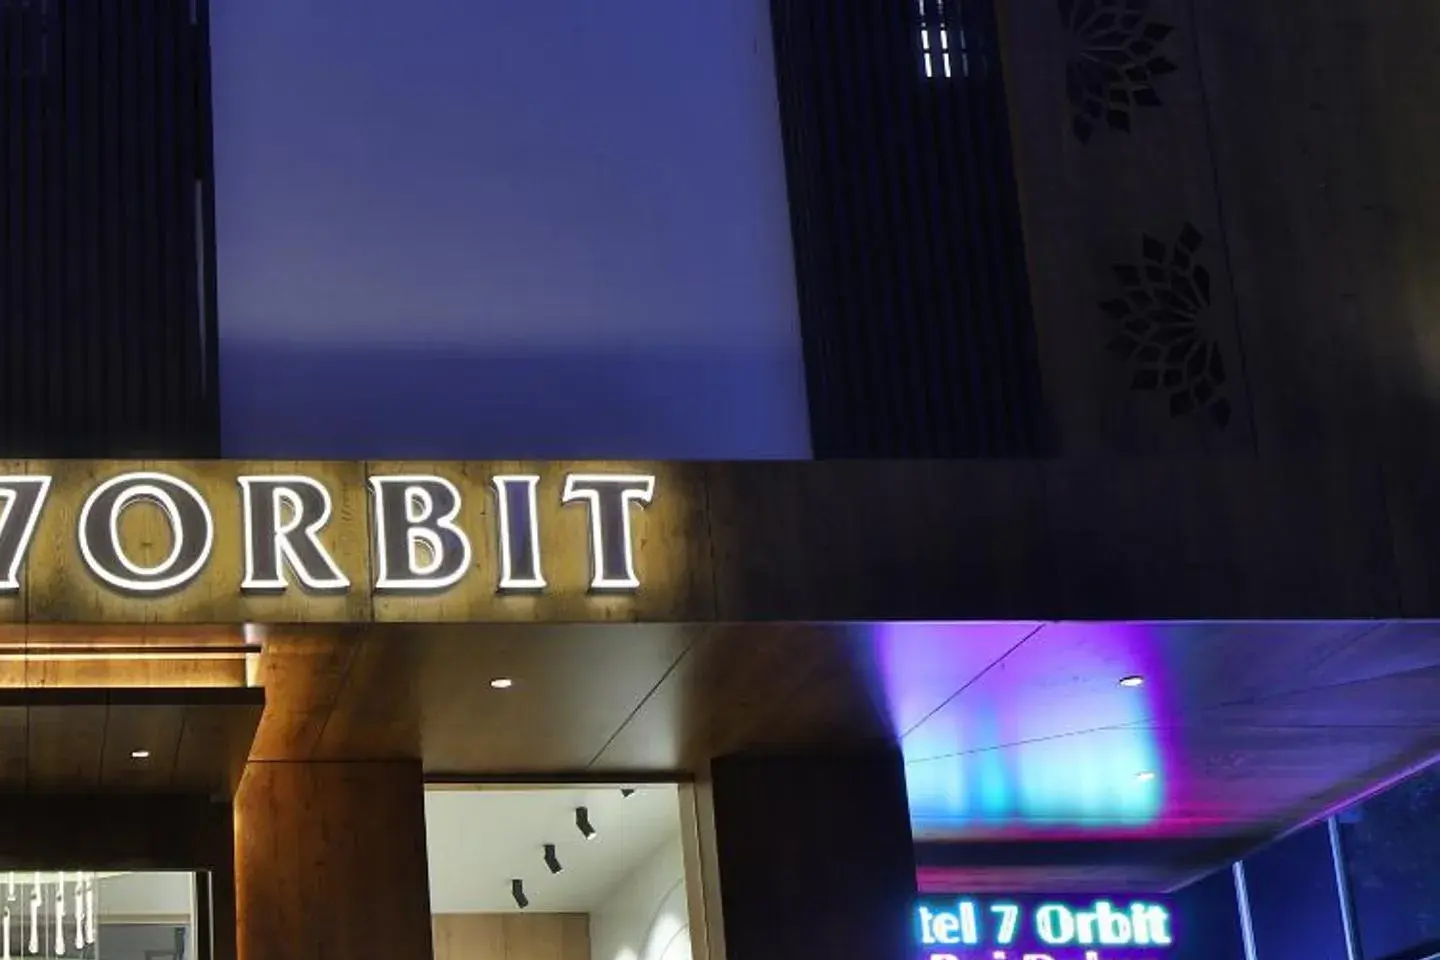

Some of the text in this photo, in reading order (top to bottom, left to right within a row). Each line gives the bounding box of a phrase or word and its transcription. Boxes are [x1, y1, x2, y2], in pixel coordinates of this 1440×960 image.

[78, 472, 656, 593] ORBIT
[990, 904, 1019, 944] 7
[1035, 901, 1172, 945] Orbit
